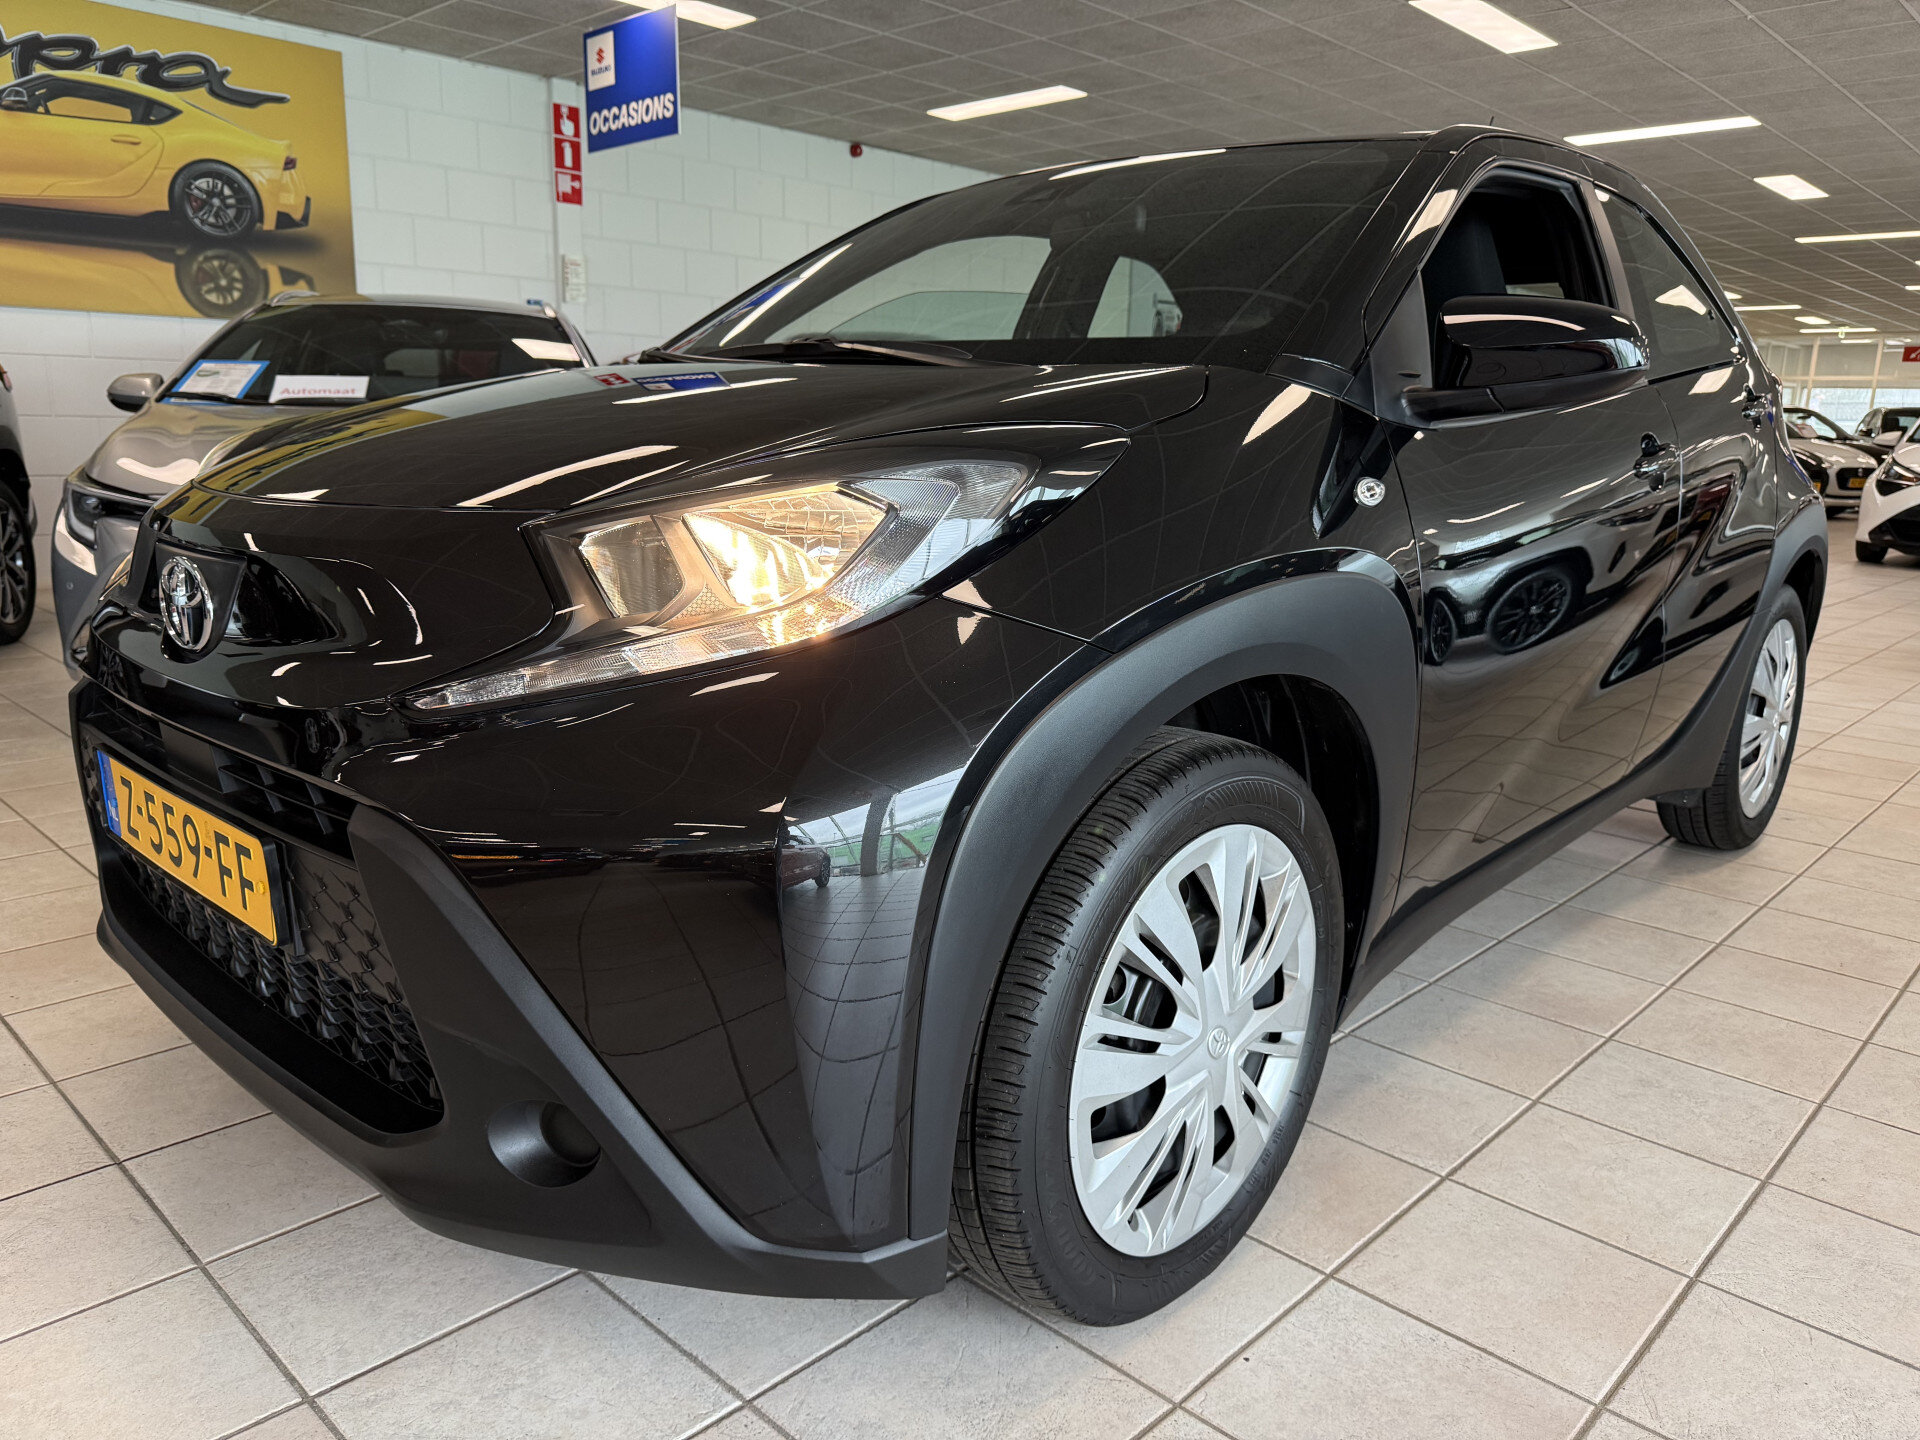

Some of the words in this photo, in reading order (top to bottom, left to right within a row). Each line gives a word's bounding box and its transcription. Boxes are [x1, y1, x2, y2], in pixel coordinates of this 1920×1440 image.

[0, 25, 291, 109] pra
[589, 92, 675, 136] OCCASIONS
[280, 387, 356, 395] Automaat
[120, 775, 255, 911] Z-559-FF
